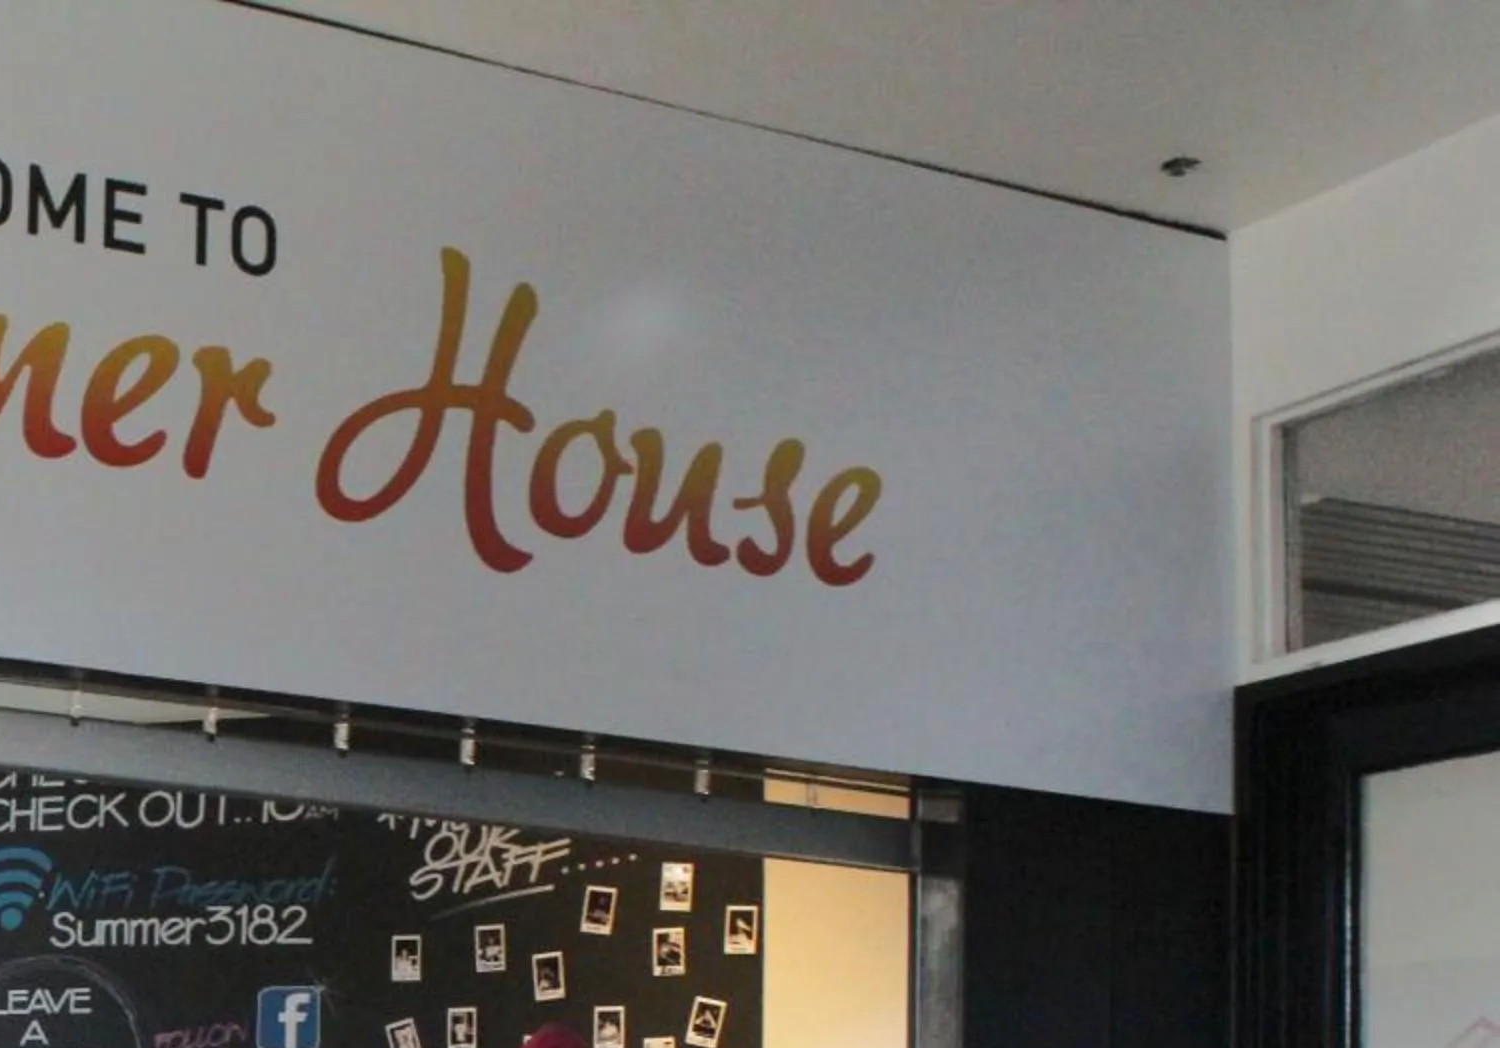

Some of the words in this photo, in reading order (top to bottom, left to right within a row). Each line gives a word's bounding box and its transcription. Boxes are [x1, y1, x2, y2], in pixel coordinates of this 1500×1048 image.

[179, 192, 277, 277] TO
[315, 246, 883, 588] House
[49, 902, 314, 950] Summer3182
[20, 1020, 49, 1045] A
